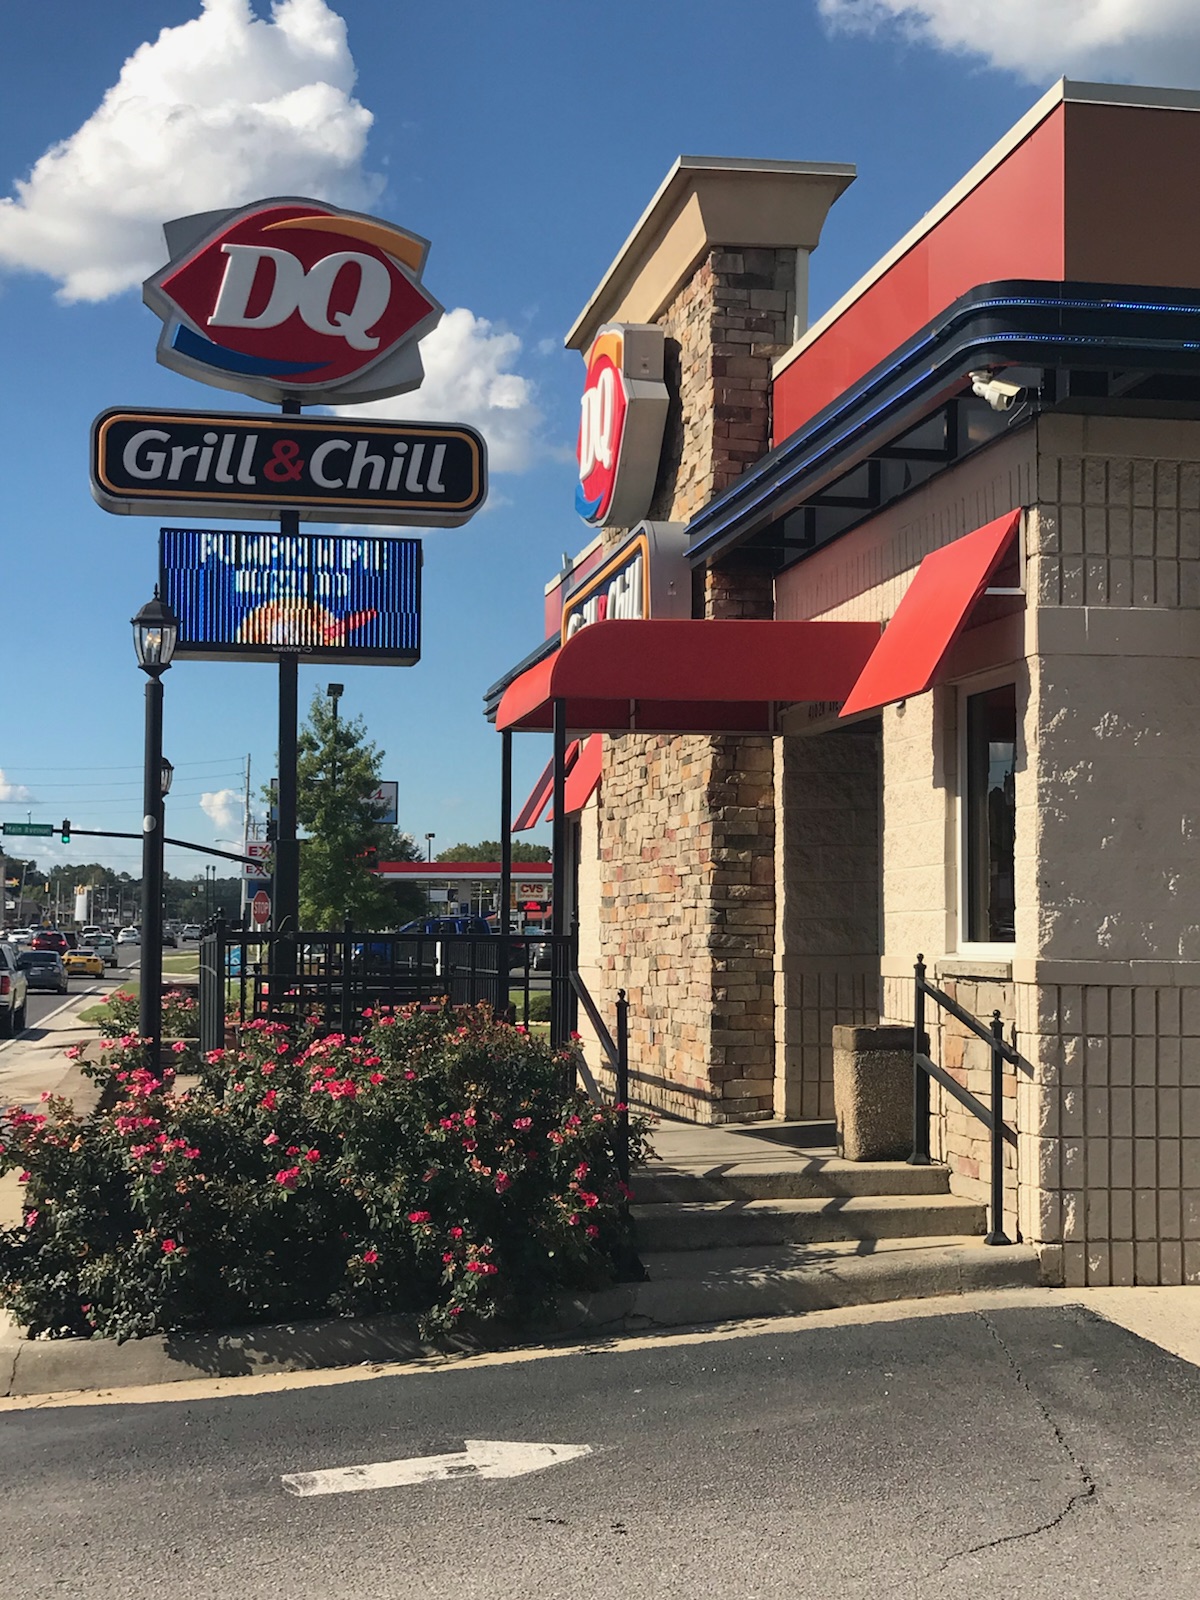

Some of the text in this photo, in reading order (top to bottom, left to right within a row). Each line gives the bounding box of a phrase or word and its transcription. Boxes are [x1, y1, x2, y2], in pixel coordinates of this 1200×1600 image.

[207, 243, 391, 351] DQ
[579, 367, 612, 481] DQ
[123, 430, 258, 485] Grill
[309, 439, 447, 493] Chill
[567, 595, 599, 641] Gill
[5, 825, 51, 836] Main Avenue
[254, 901, 269, 914] STOP
[520, 884, 544, 893] CVS
